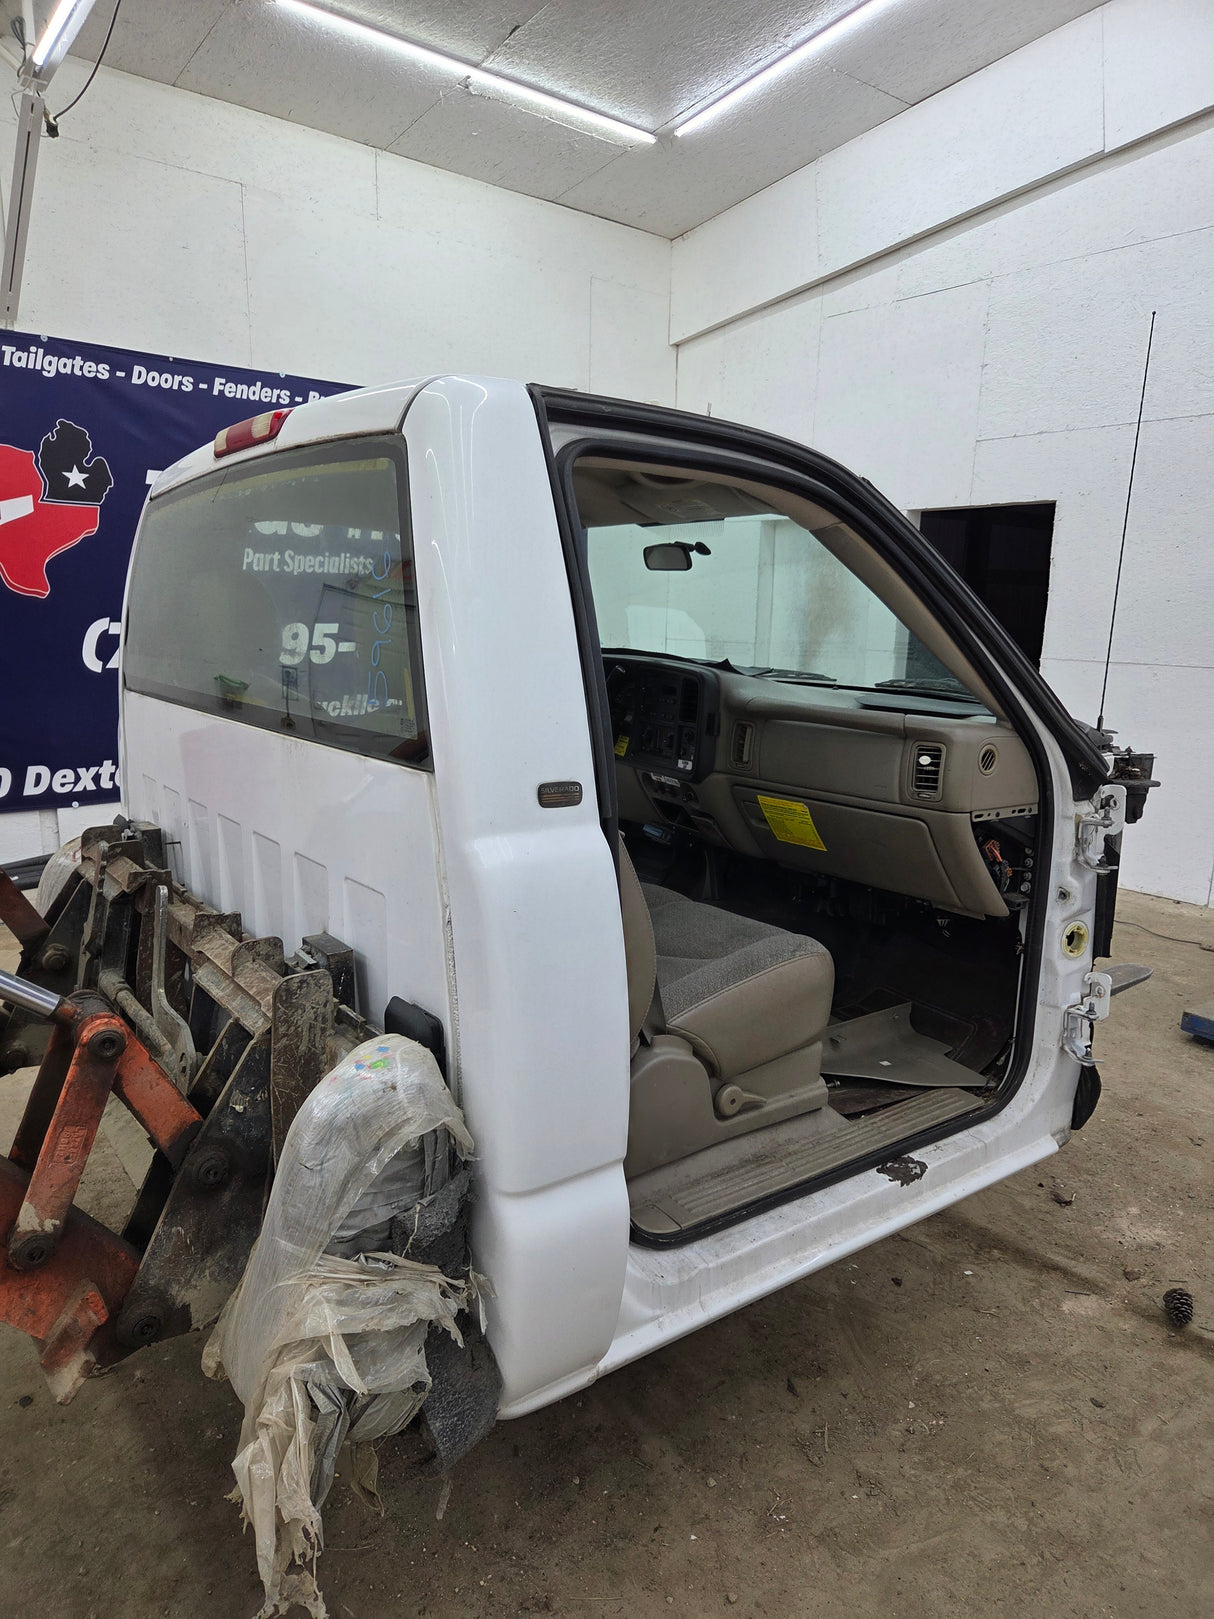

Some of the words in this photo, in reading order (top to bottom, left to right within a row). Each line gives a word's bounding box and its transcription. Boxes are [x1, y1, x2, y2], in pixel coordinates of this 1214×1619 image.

[2, 345, 110, 379] Tailgates
[131, 365, 194, 391] Doors
[213, 377, 291, 404] Fenders
[242, 548, 280, 572] Part
[284, 550, 373, 575] Specialists
[23, 760, 120, 796] Dext
